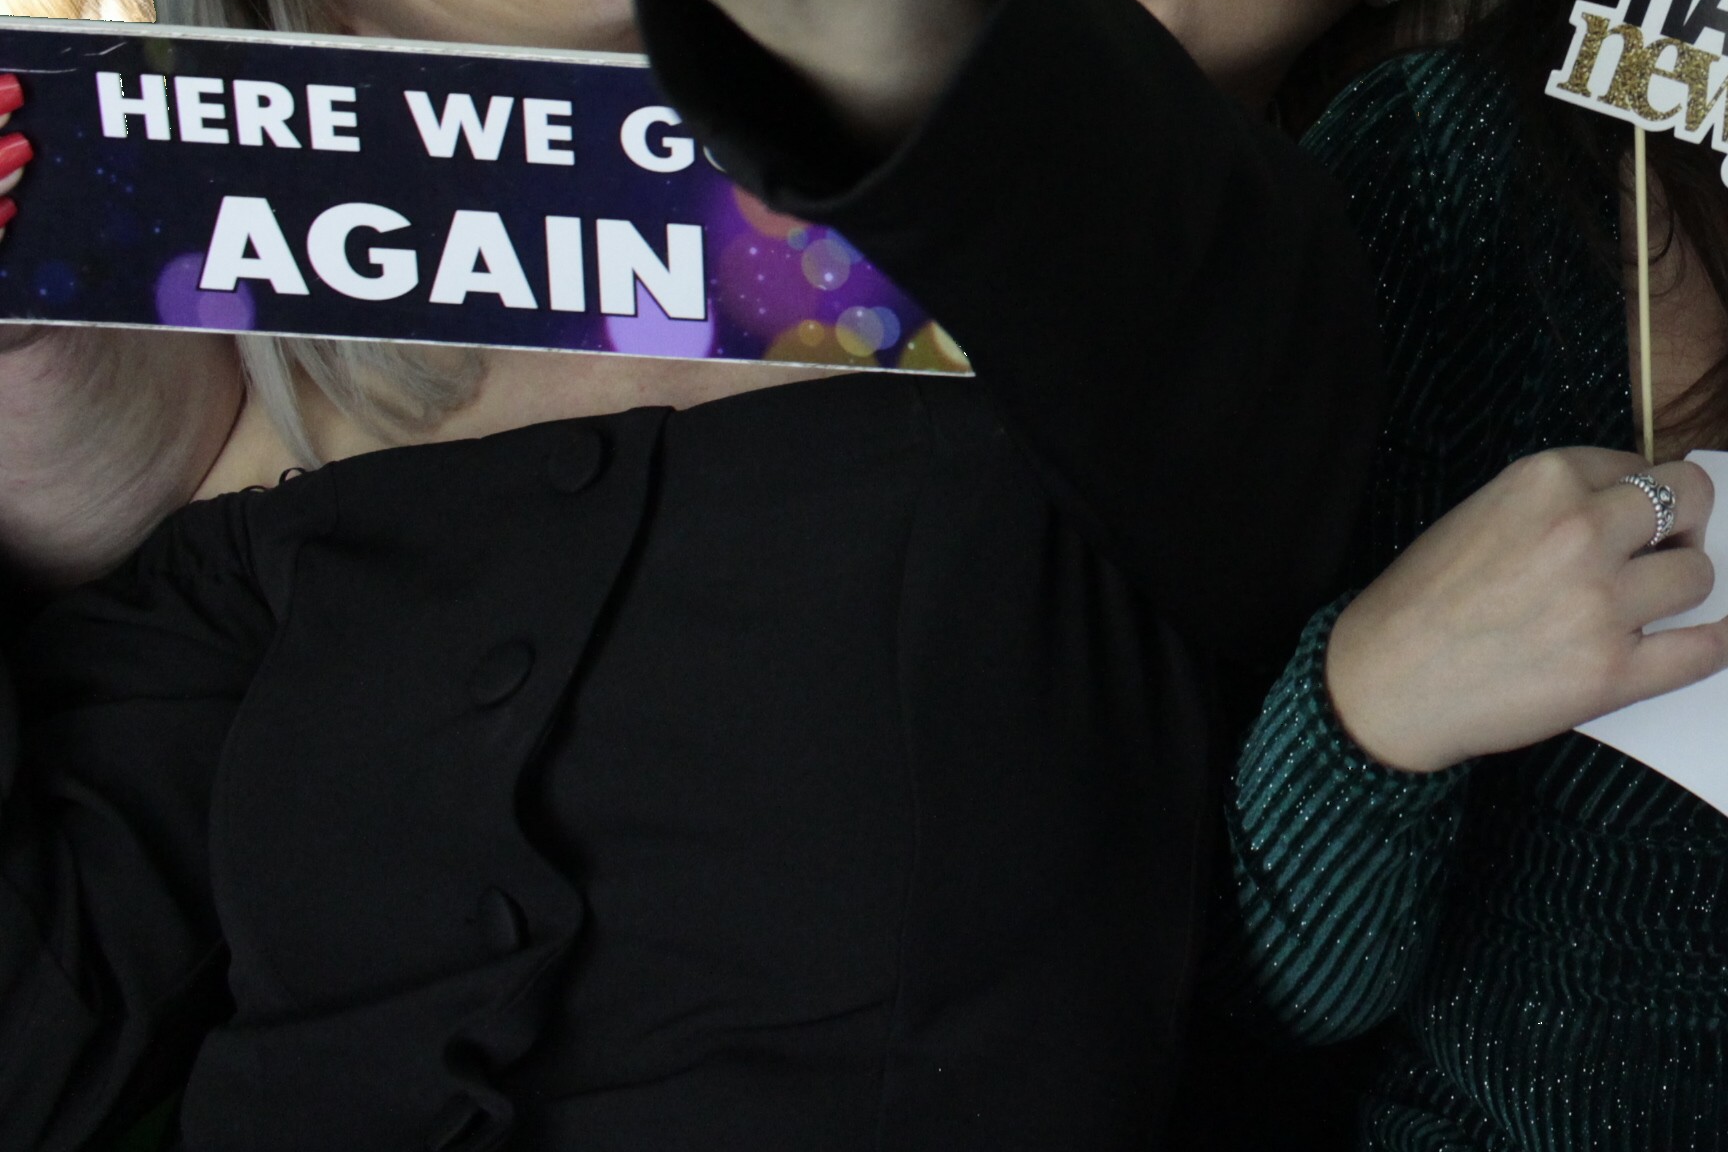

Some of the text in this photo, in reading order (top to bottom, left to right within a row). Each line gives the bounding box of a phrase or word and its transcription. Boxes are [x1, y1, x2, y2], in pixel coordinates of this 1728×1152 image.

[96, 71, 728, 174] HERE WE G
[199, 195, 709, 322] AGAIN
